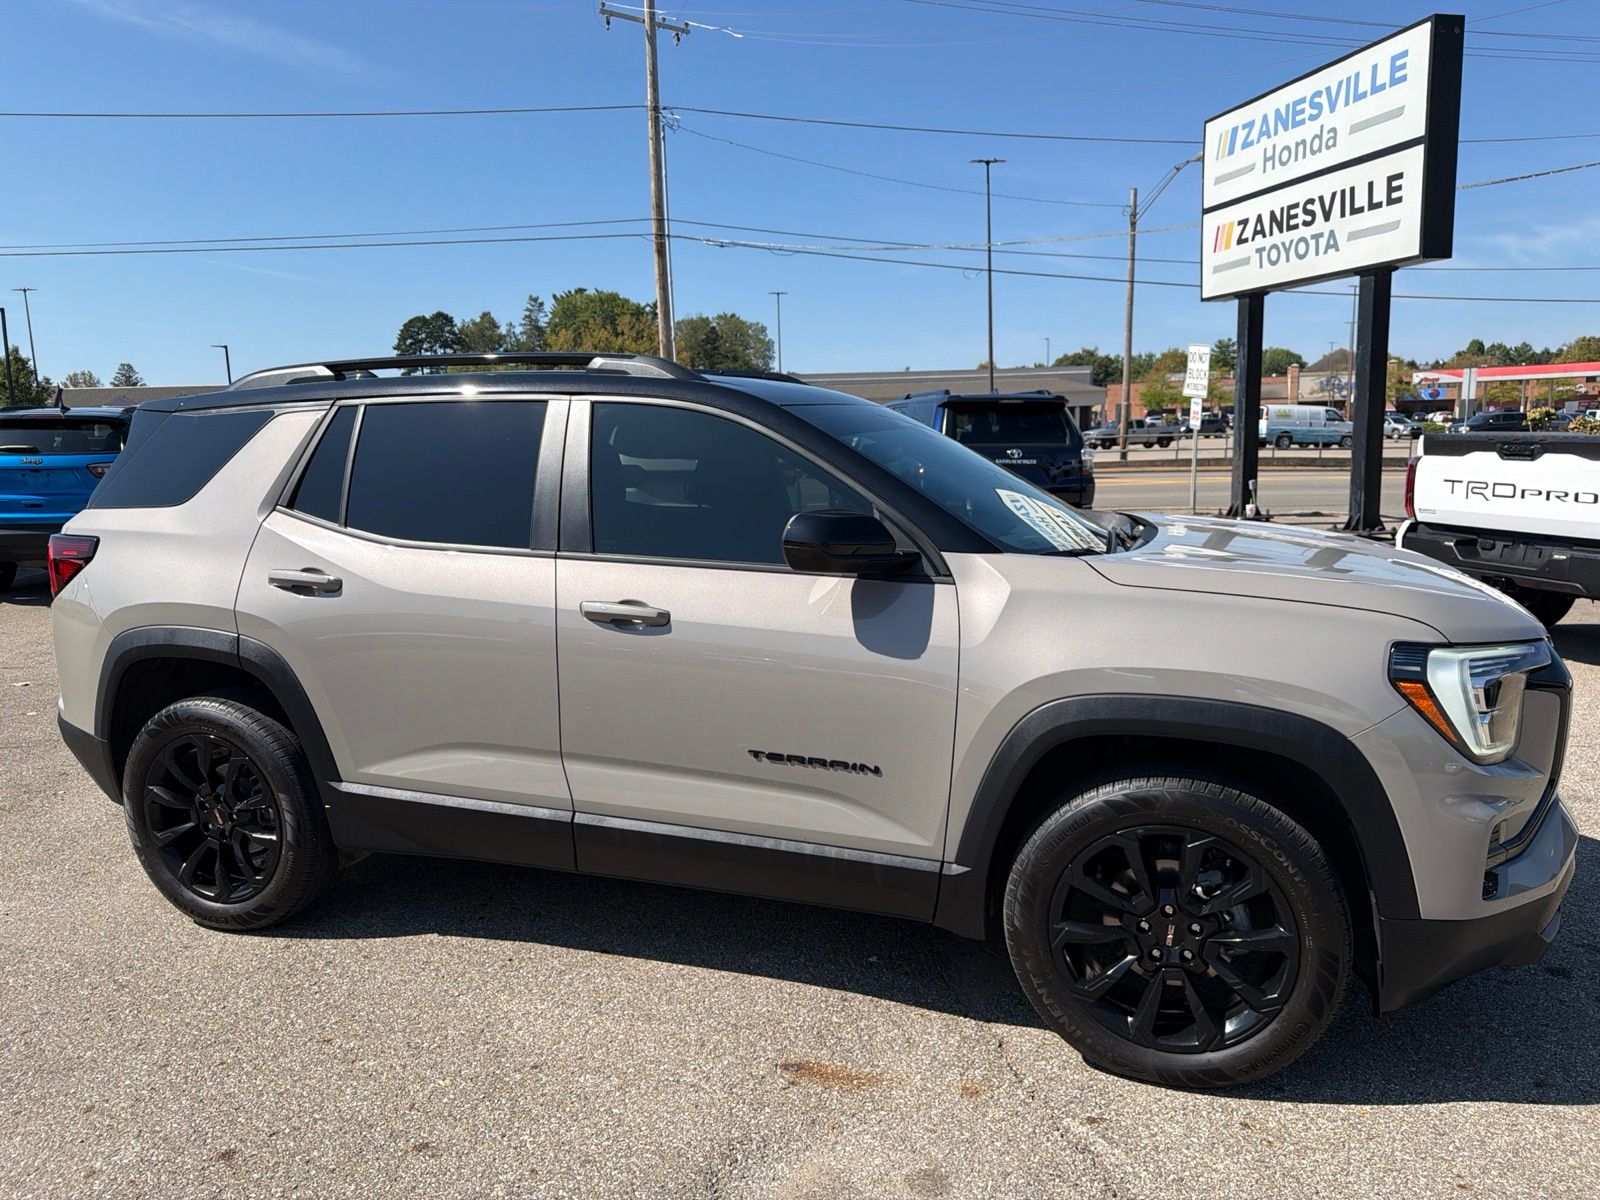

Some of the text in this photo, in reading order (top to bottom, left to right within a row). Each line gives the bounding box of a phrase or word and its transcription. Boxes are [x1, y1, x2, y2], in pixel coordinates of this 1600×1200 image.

[1240, 49, 1409, 151] ZANESVILLE
[1262, 124, 1338, 174] Honda
[1236, 171, 1404, 246] ZANESVILLE
[1255, 229, 1340, 269] TOYOTA
[1188, 367, 1208, 381] BLOCK
[1189, 351, 1209, 364] DO NOT
[20, 456, 43, 465] Jeep
[748, 750, 882, 776] TERRAIN
